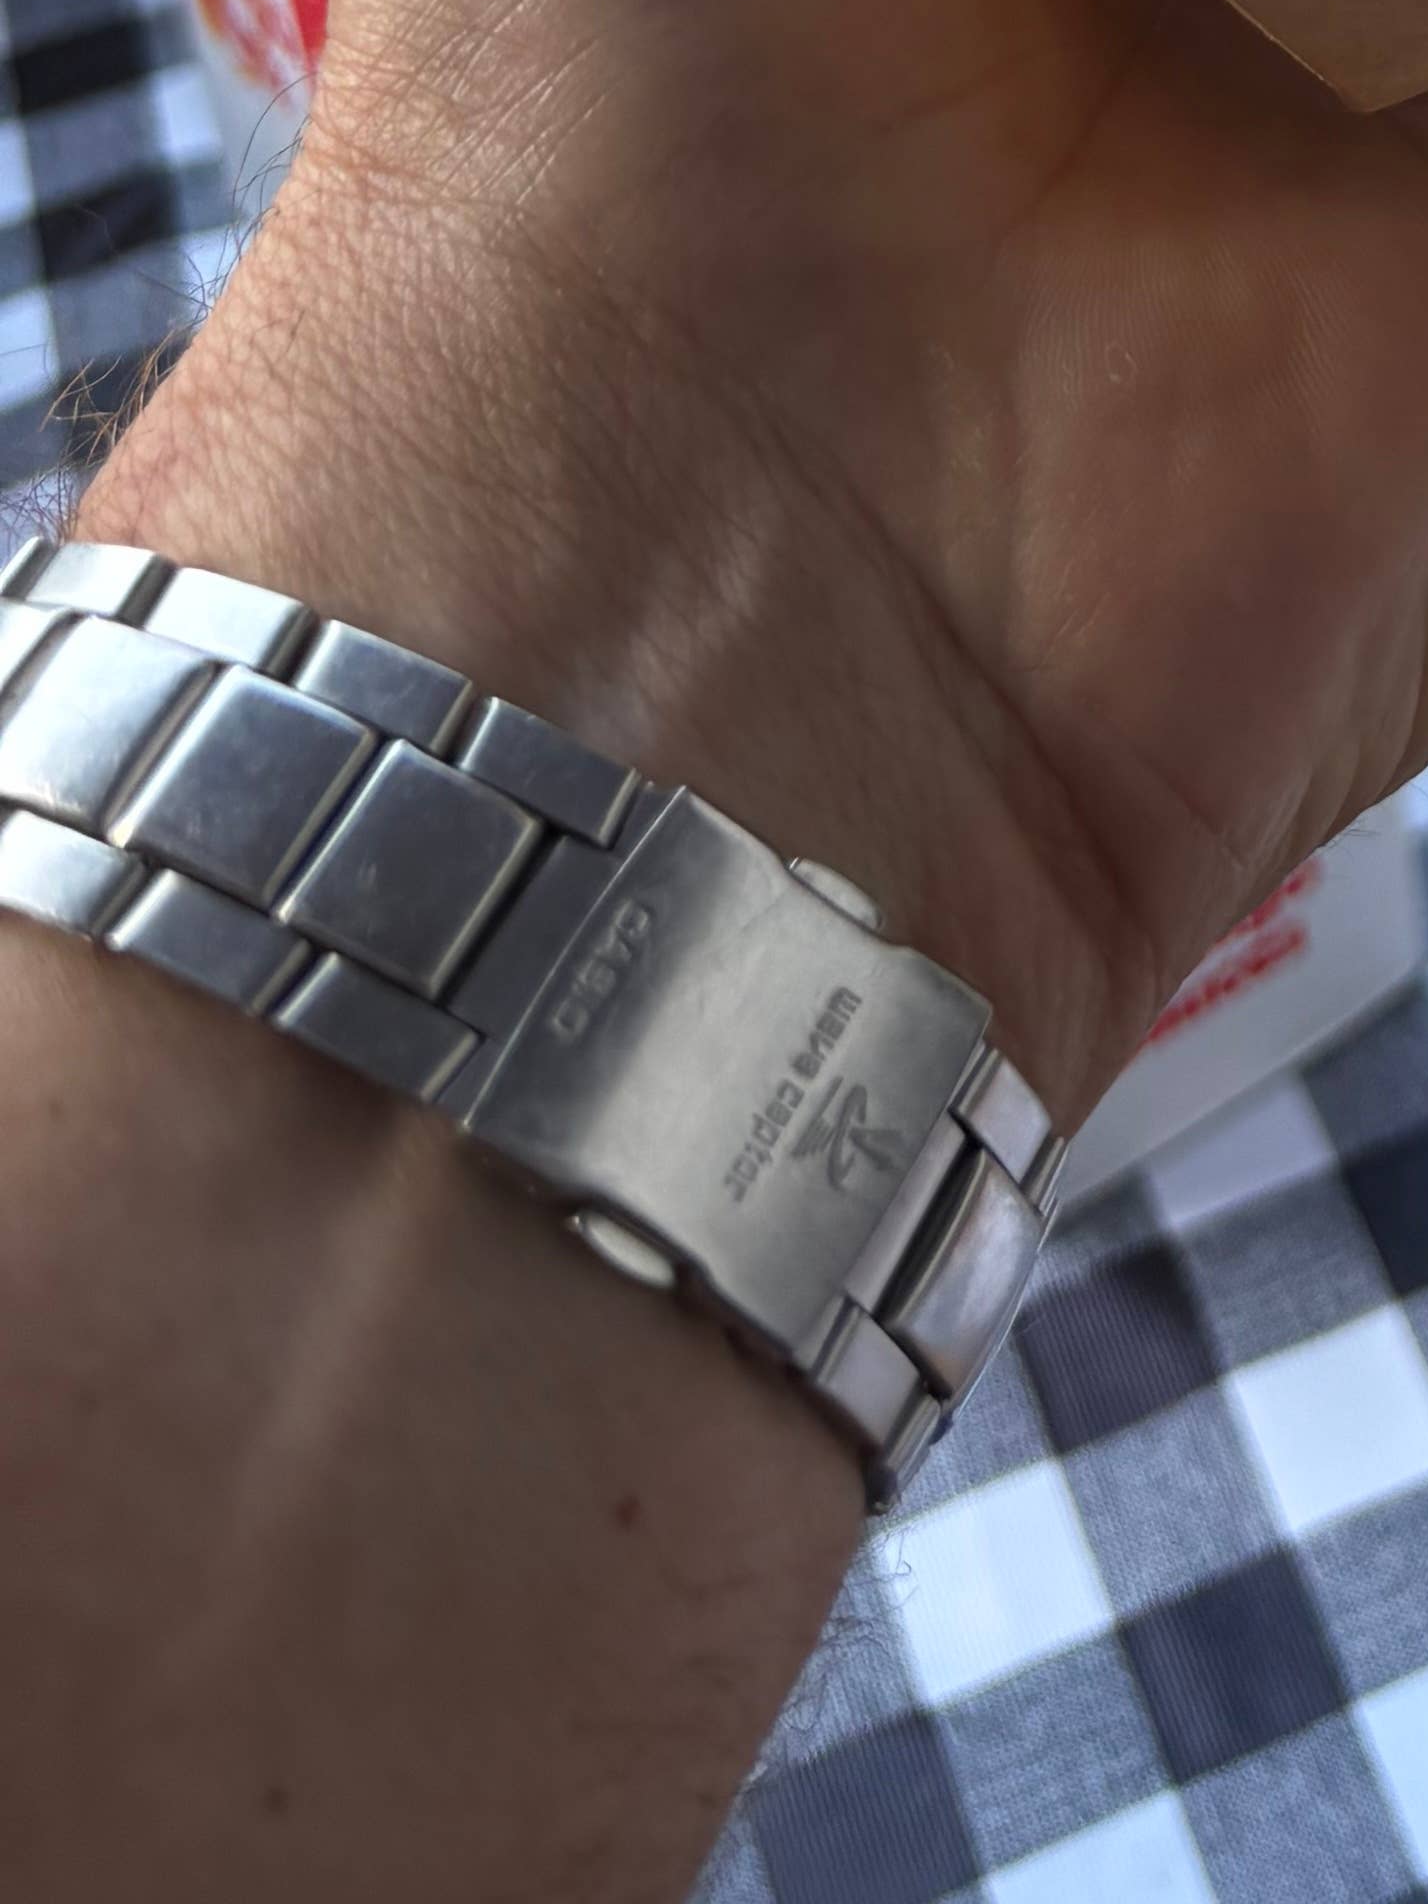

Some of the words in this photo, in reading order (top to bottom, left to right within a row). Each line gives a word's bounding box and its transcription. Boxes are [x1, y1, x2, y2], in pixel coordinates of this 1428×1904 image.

[550, 896, 653, 1048] CASIO
[791, 986, 863, 1081] wave
[724, 1078, 805, 1204] ceptor
